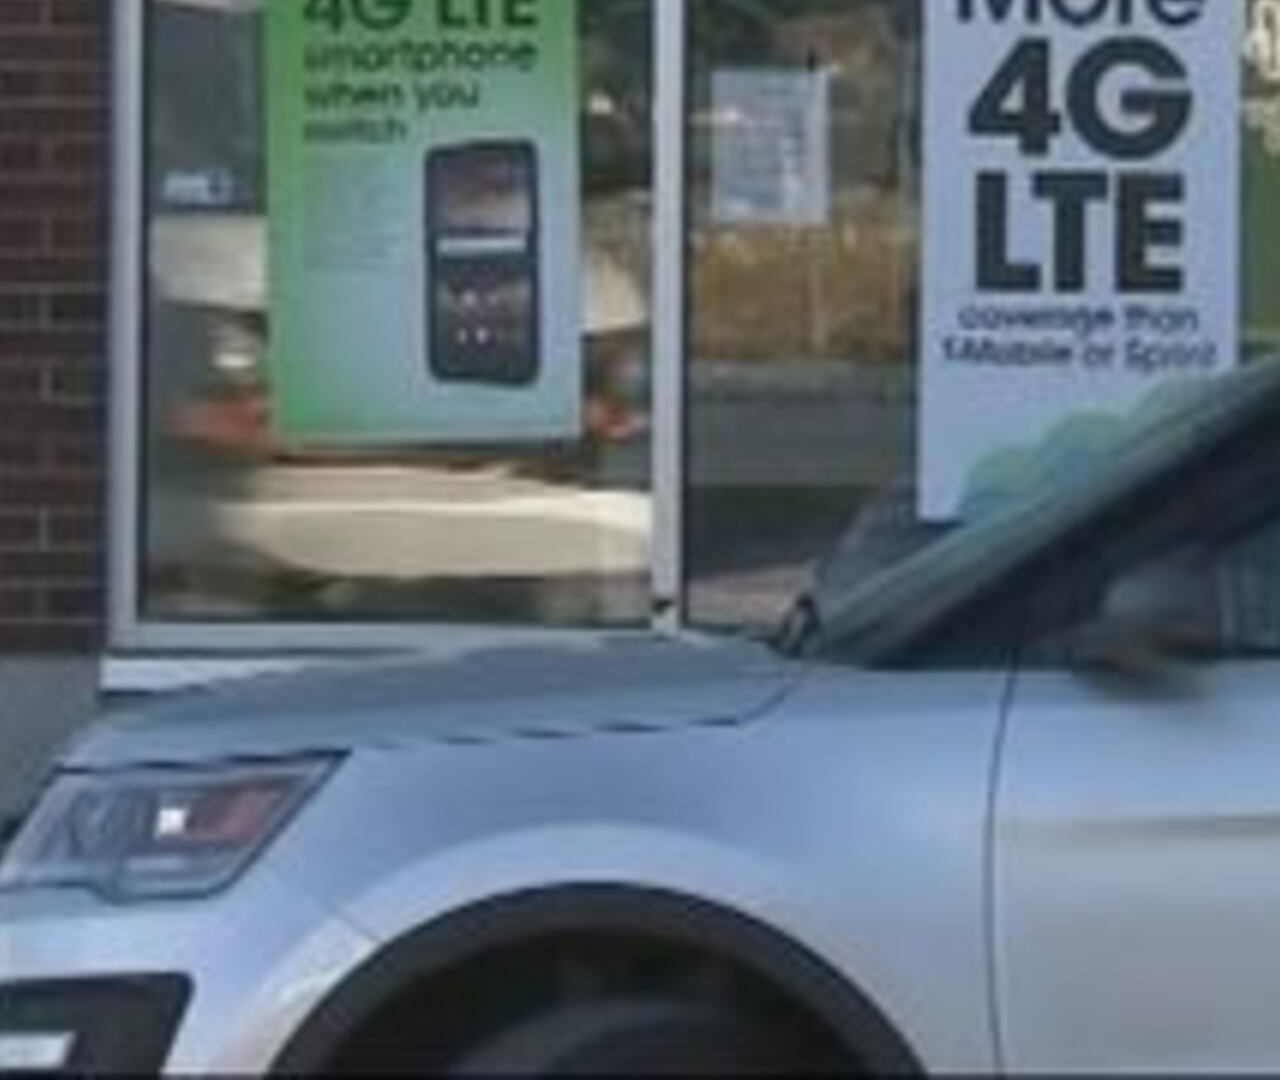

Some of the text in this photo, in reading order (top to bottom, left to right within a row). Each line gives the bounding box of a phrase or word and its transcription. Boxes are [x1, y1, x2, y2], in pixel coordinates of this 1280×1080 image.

[303, 80, 481, 115] when you
[966, 35, 1195, 163] 4G
[973, 170, 1186, 294] LTE
[1123, 303, 1201, 334] than
[1081, 340, 1116, 368] or
[1123, 336, 1218, 374] Sprint
